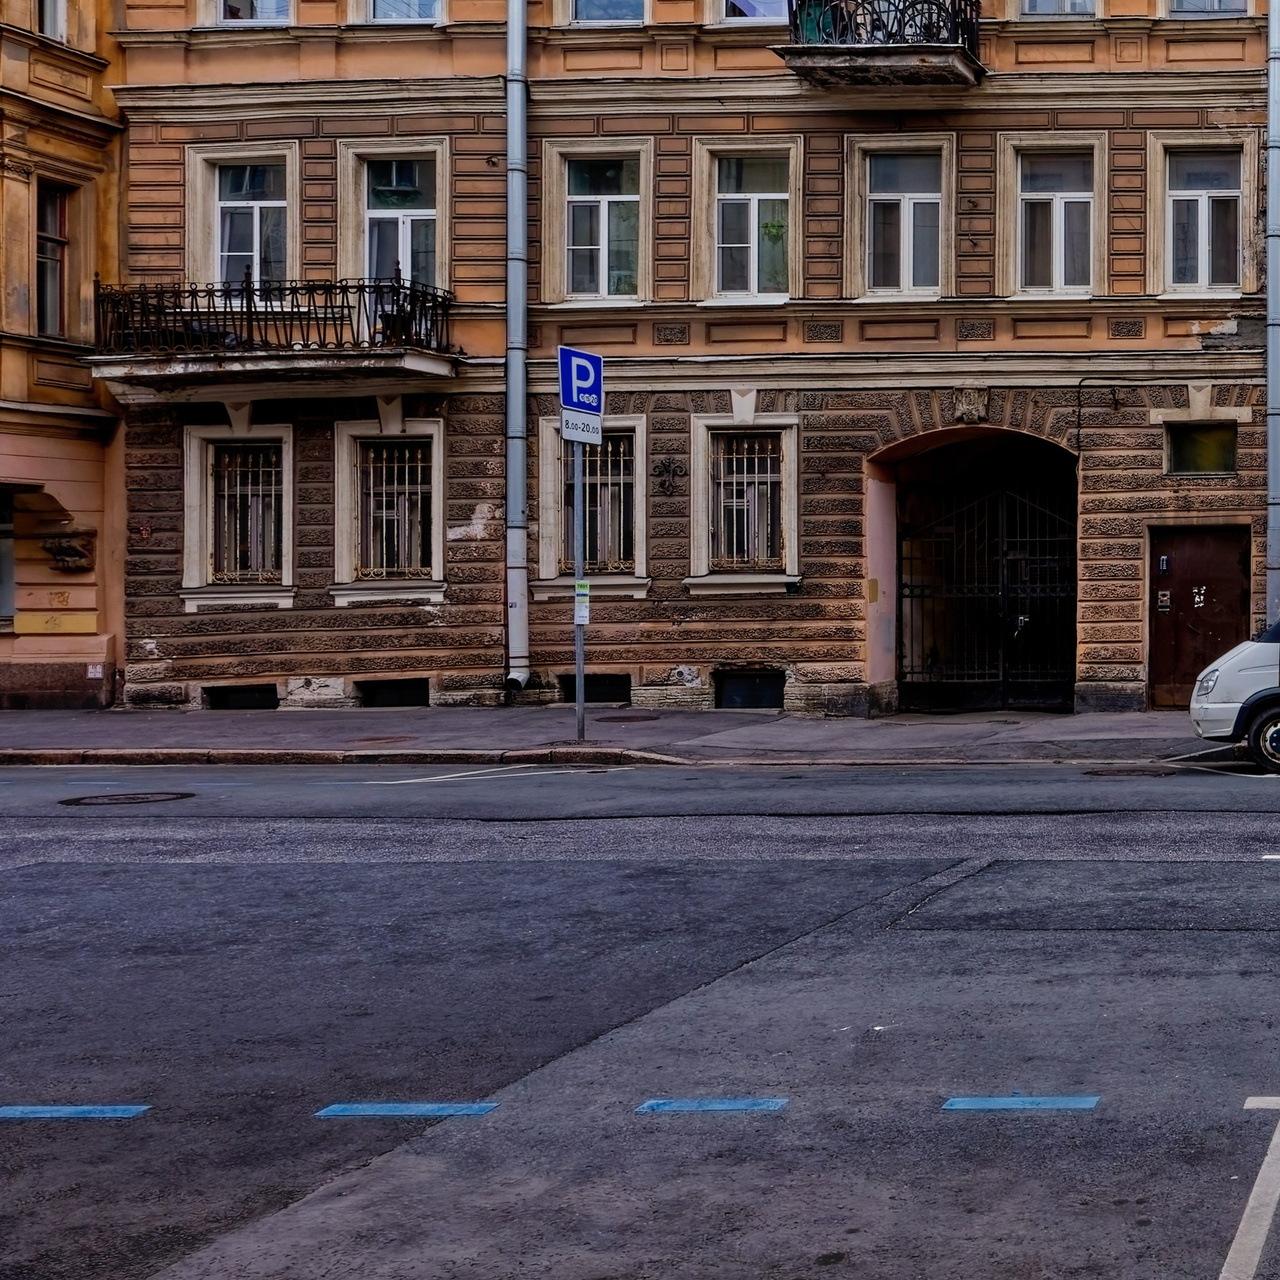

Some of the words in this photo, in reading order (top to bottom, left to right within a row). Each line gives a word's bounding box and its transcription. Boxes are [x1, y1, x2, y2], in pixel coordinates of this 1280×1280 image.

[571, 356, 595, 403] P
[591, 395, 599, 405] 20
[564, 419, 600, 435] 8.00-20.00
